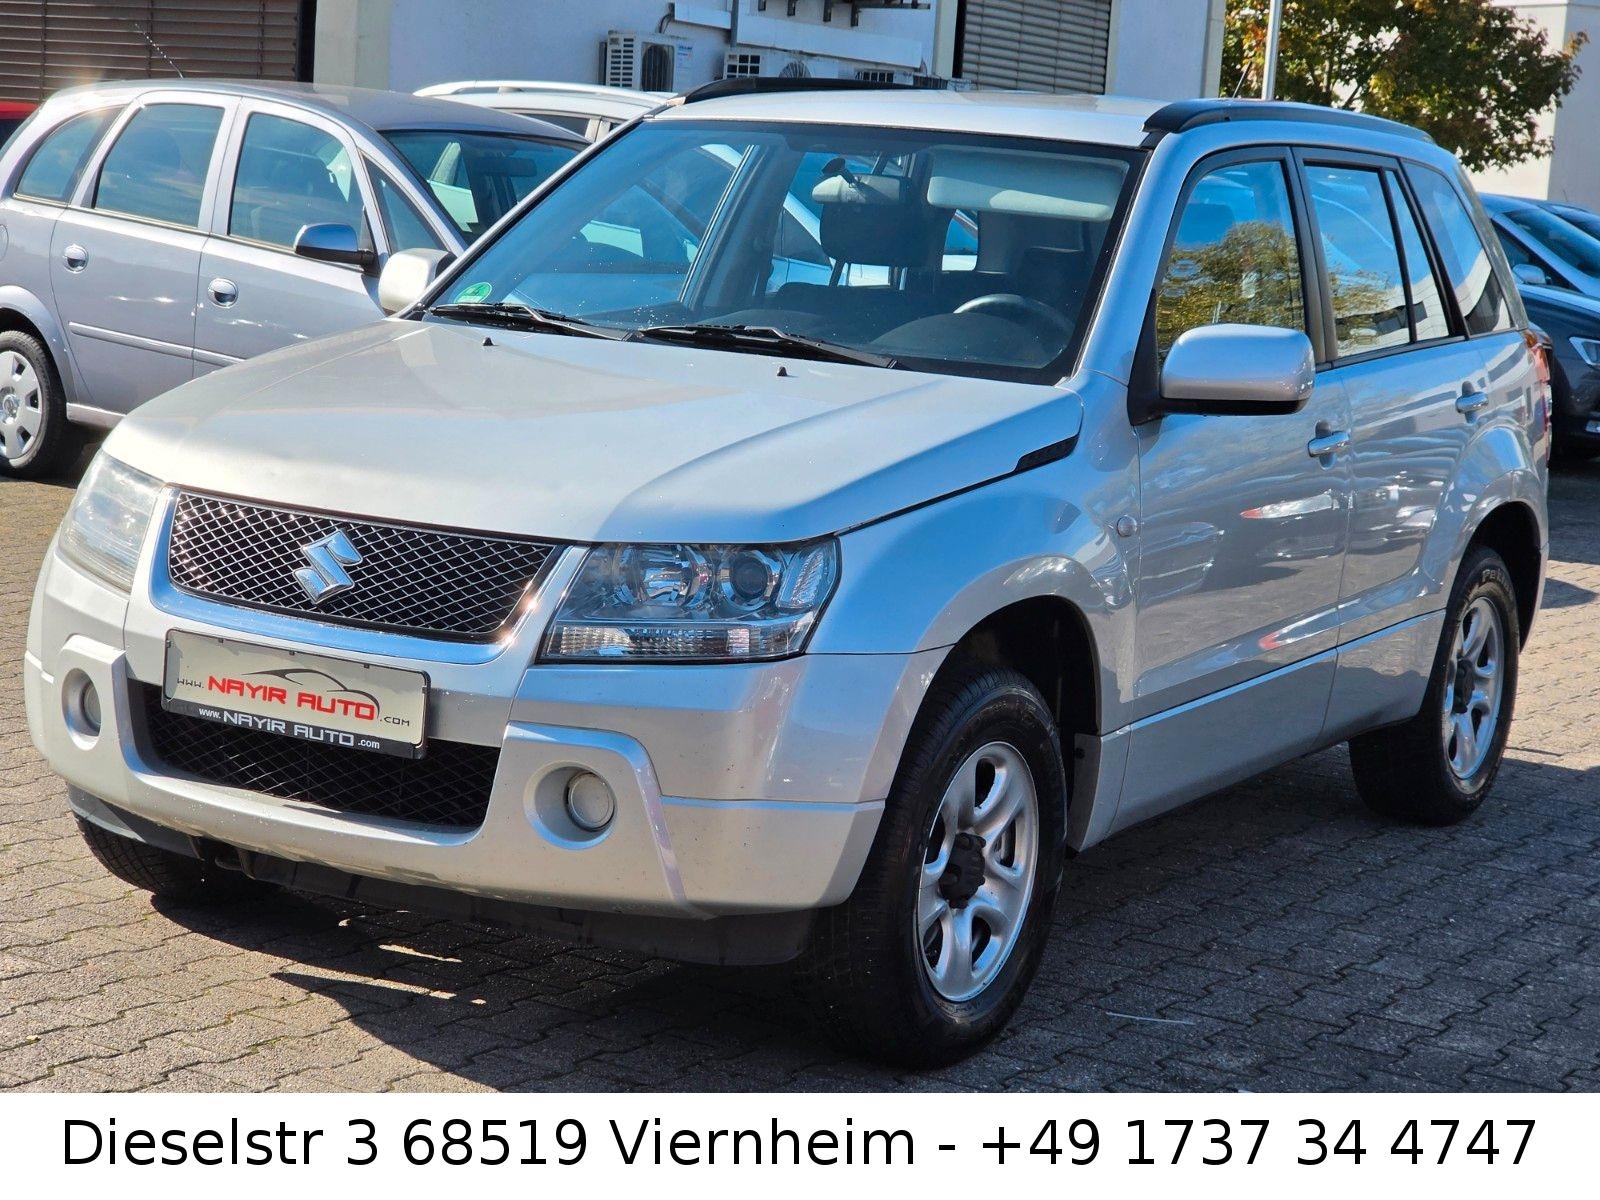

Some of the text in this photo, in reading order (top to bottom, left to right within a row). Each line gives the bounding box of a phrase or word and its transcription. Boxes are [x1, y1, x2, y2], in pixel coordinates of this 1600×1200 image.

[208, 675, 287, 704] NAYIR
[297, 691, 375, 721] AUTO
[199, 708, 222, 719] www.
[294, 724, 354, 747] AUTO
[358, 739, 380, 749] .com
